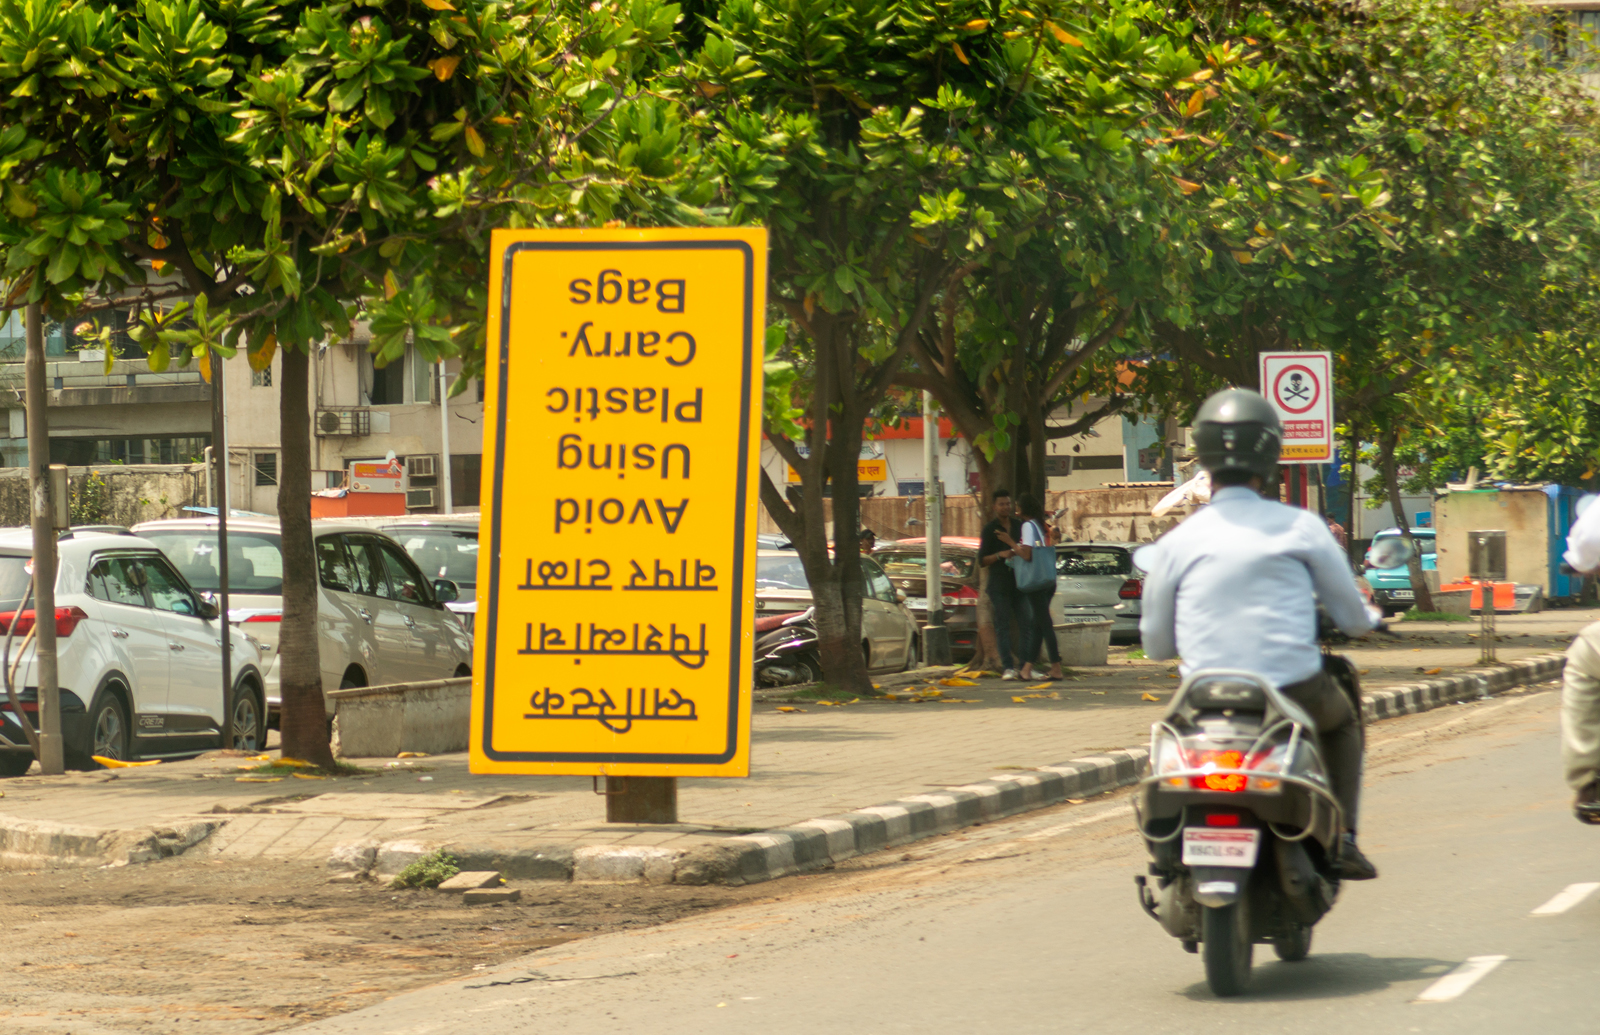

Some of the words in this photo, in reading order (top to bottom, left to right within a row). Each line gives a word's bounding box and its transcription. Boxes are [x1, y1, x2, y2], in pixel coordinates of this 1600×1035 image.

[569, 269, 686, 314] Bags
[561, 321, 697, 367] Carry.
[547, 387, 703, 423] Plastic
[558, 433, 691, 479] Using
[554, 498, 689, 534] Avoid
[517, 558, 613, 591] टाळा
[623, 559, 718, 591] वापर
[517, 622, 709, 670] पिशव्यांचा
[139, 717, 164, 726] CRETA
[524, 687, 698, 734] प्लास्टिक
